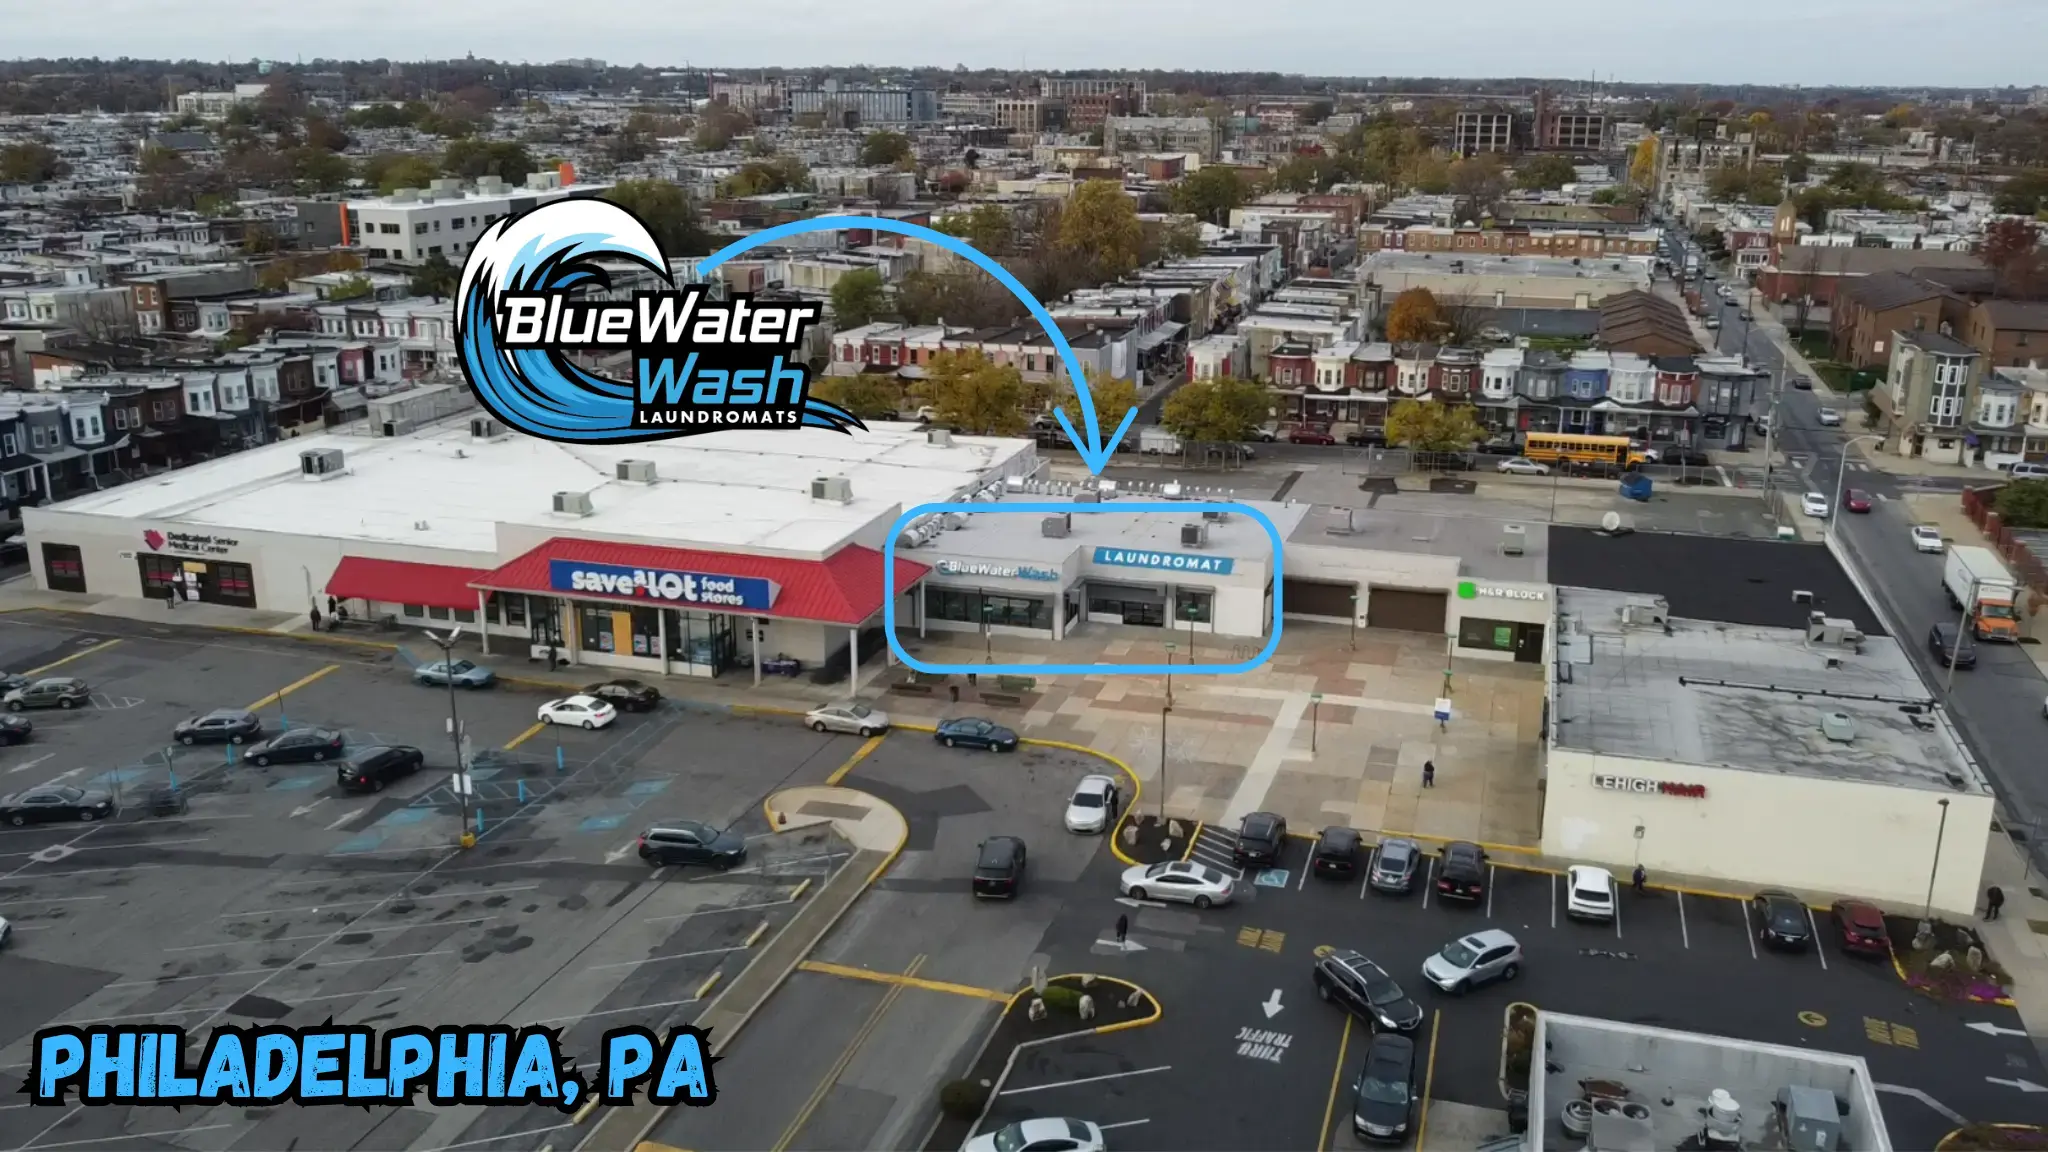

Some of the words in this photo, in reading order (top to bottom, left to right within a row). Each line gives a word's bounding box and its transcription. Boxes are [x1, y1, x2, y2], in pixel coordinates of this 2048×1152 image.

[167, 532, 211, 543] Dedicated
[213, 535, 239, 546] Senior
[168, 540, 199, 551] Medical
[201, 542, 229, 554] Center
[1104, 550, 1222, 571] LAUNDROMAT
[701, 576, 734, 593] food
[701, 592, 744, 606] stores
[1479, 587, 1503, 597] H&R
[1506, 589, 1545, 601] BLOCK
[1592, 774, 1659, 793] LEHIGH
[1234, 1026, 1293, 1048] TRAFFIC
[1237, 1041, 1283, 1064] THRU
